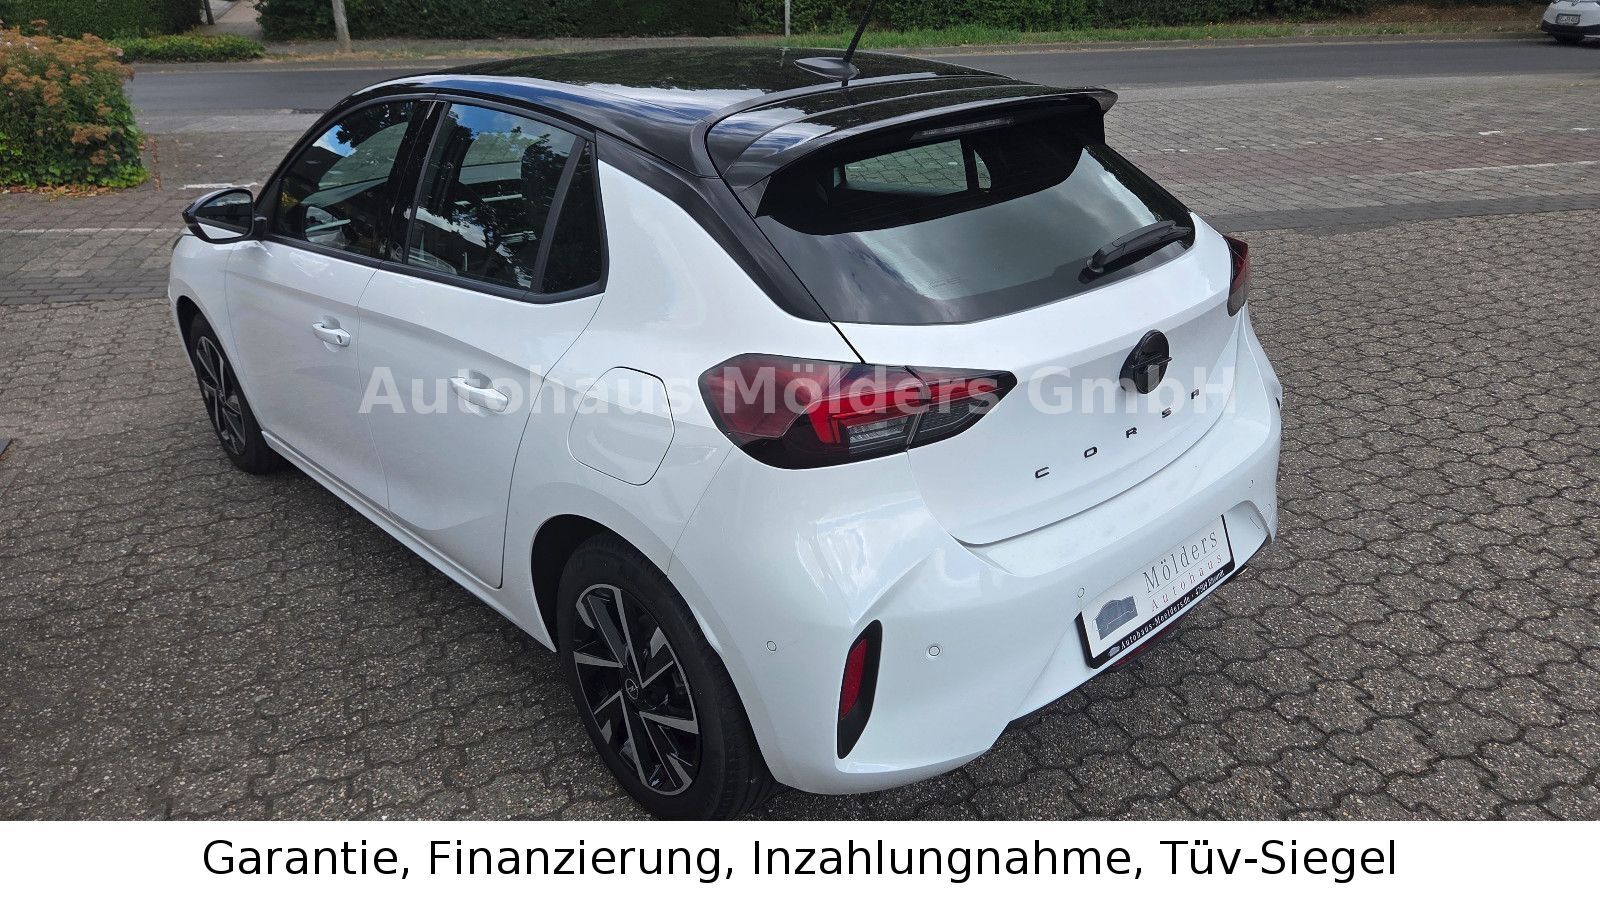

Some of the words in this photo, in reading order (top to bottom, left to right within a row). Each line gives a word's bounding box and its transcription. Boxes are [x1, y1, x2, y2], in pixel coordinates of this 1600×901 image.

[1034, 389, 1200, 479] CORSA
[1142, 532, 1217, 593] Mölders
[1152, 554, 1222, 612] Autohaus
